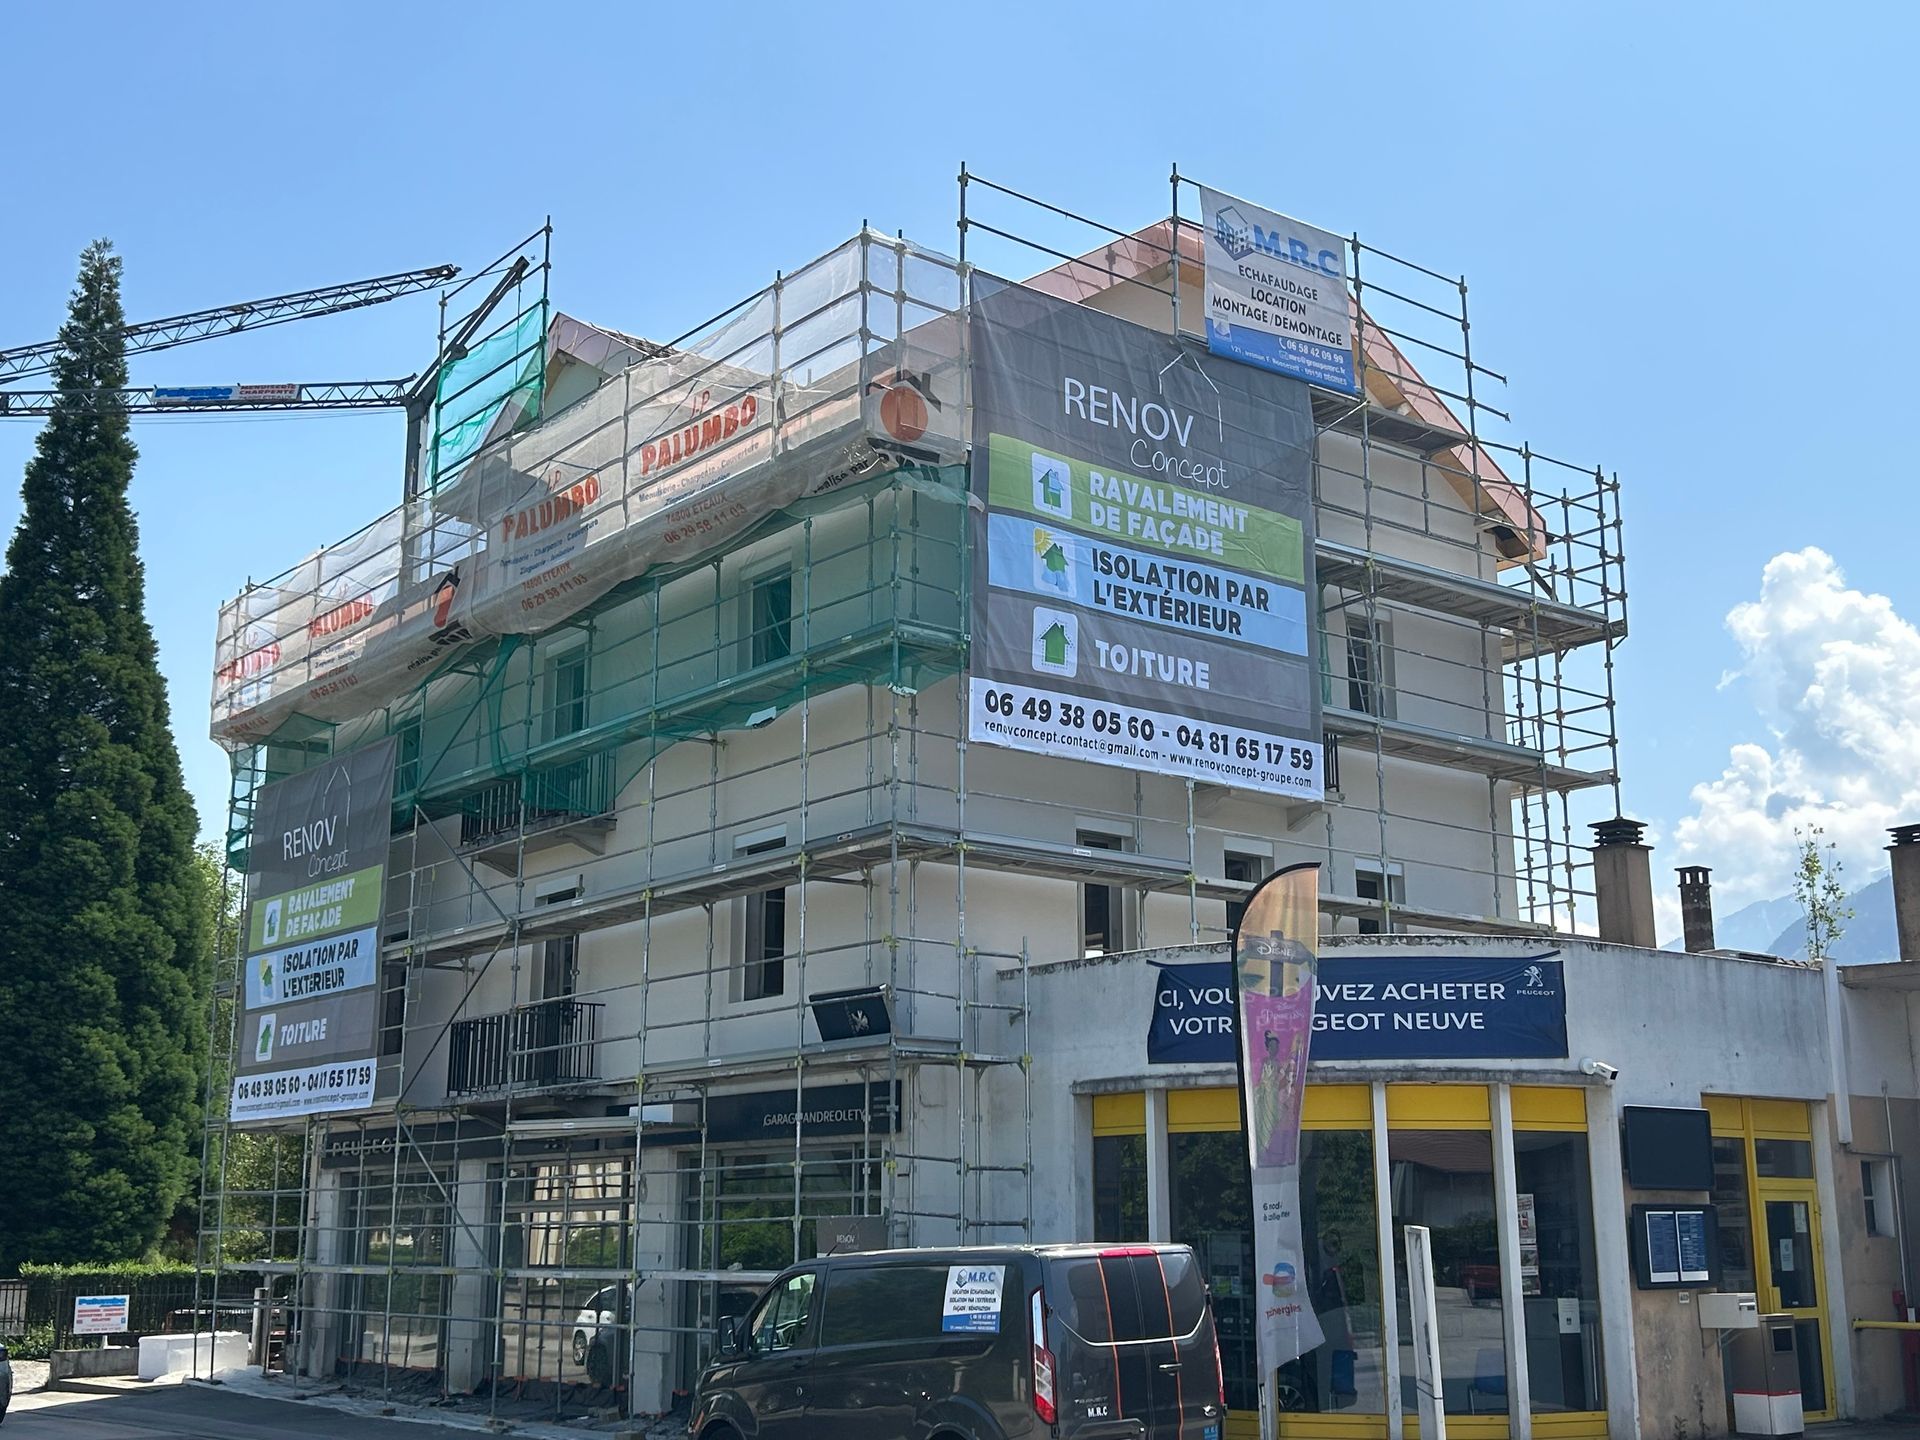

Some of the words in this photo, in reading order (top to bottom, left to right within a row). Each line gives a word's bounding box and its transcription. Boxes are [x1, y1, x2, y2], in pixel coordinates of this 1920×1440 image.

[1253, 224, 1340, 277] M.R.C
[1238, 264, 1318, 300] ECHAFAUDAGE
[1251, 287, 1306, 316] LOCATION
[1286, 339, 1296, 350] 06
[1299, 342, 1308, 354] 58
[1310, 345, 1320, 357] 42
[1322, 349, 1332, 361] 09
[1333, 353, 1344, 364] 99
[1064, 377, 1194, 447] RENOV
[641, 395, 756, 476] PALUMBO
[1130, 438, 1230, 489] Concept
[502, 476, 599, 544] PALUMBO
[1089, 471, 1248, 533] RAVALEMENT
[1090, 502, 1121, 532] DE
[1126, 510, 1224, 556] FAÇADE
[1092, 548, 1220, 600] ISOLATION
[1226, 579, 1269, 612] PAR
[1093, 580, 1242, 636] L'EXTÉRIEUR
[1095, 639, 1210, 690] TOITURE
[985, 689, 1014, 716] 06
[1022, 697, 1052, 723] 49
[1059, 703, 1085, 728] 38
[1092, 709, 1122, 735] 05
[1127, 716, 1154, 742] 60
[1176, 725, 1204, 750] 04
[1209, 732, 1229, 756] 81
[1235, 737, 1260, 761] 65
[1265, 742, 1284, 765] 17
[1290, 748, 1313, 771] 59
[984, 720, 1159, 760] renovconcept.contact@gmail.com
[1169, 752, 1312, 788] www.renovconcept-groupe.com
[283, 815, 337, 861] RENOV
[308, 845, 349, 878] Concept
[288, 878, 356, 915] RAVALEMENT
[286, 916, 300, 938] DE
[282, 945, 335, 974] ISOLATION
[337, 938, 359, 962] PAR
[282, 967, 345, 998] L'EXTÉRIEUR
[1381, 982, 1506, 1001] ACHETER
[280, 1018, 327, 1047] TOITURE
[1169, 1016, 1233, 1035] VOTR
[1393, 1012, 1485, 1030] NEUVE
[238, 1082, 249, 1100] 06
[250, 1080, 260, 1098] 49
[263, 1079, 274, 1096] 38
[276, 1077, 286, 1095] 05
[288, 1076, 300, 1093] 60
[328, 1068, 344, 1088] 65
[346, 1068, 357, 1086] 17
[359, 1066, 371, 1086] 59
[762, 1112, 799, 1128] GARAG
[968, 1272, 996, 1282] M.R.C
[1087, 1406, 1108, 1418] M.R.C
